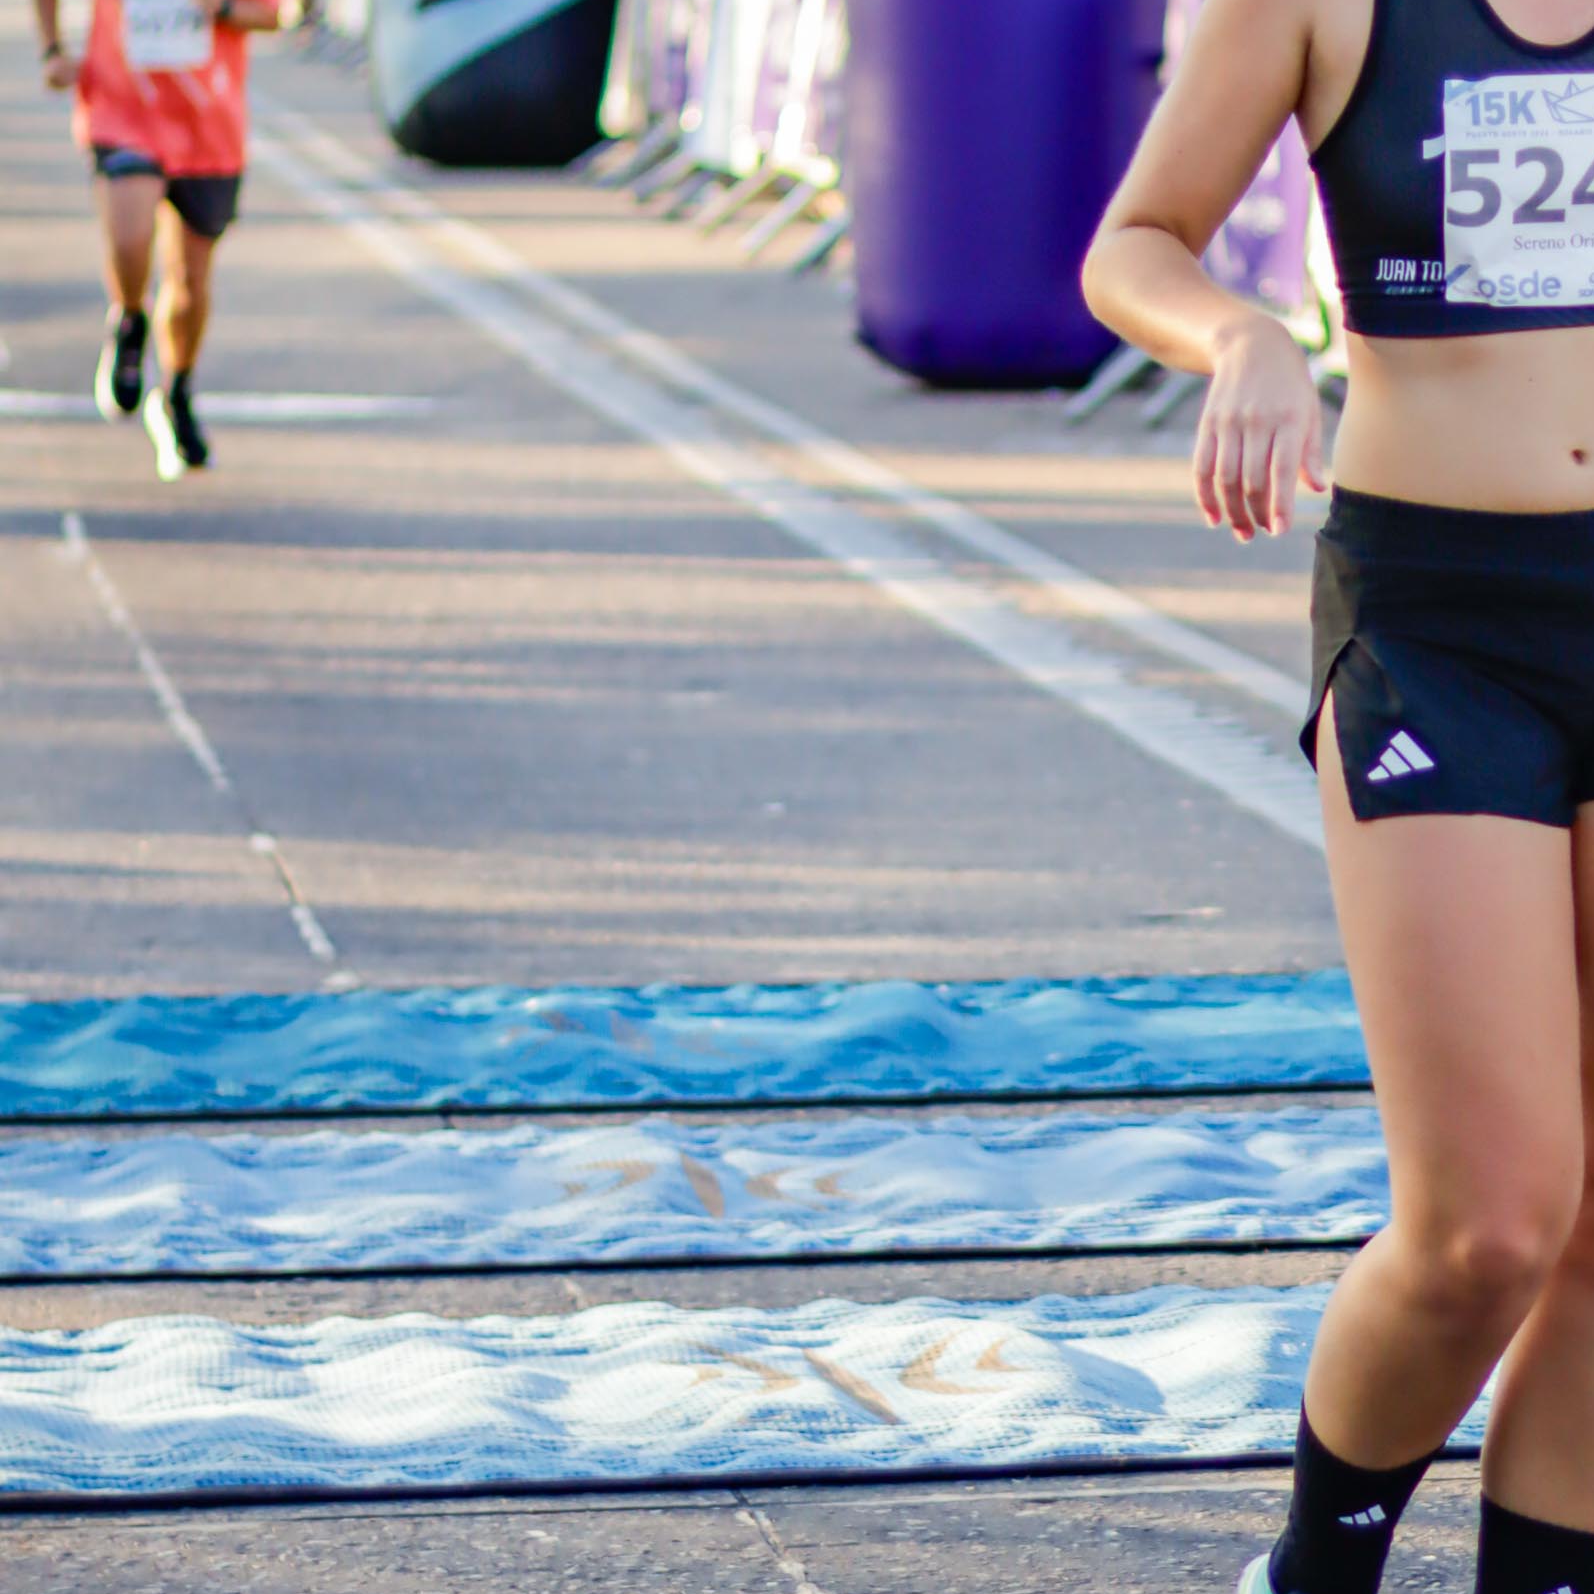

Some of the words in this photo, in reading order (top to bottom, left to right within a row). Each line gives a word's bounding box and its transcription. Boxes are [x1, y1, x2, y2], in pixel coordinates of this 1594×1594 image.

[1465, 89, 1536, 126] 15K
[1513, 234, 1565, 252] Sereno
[1376, 257, 1417, 282] JUAN
[1421, 260, 1443, 282] TO
[1477, 269, 1561, 304] osde
